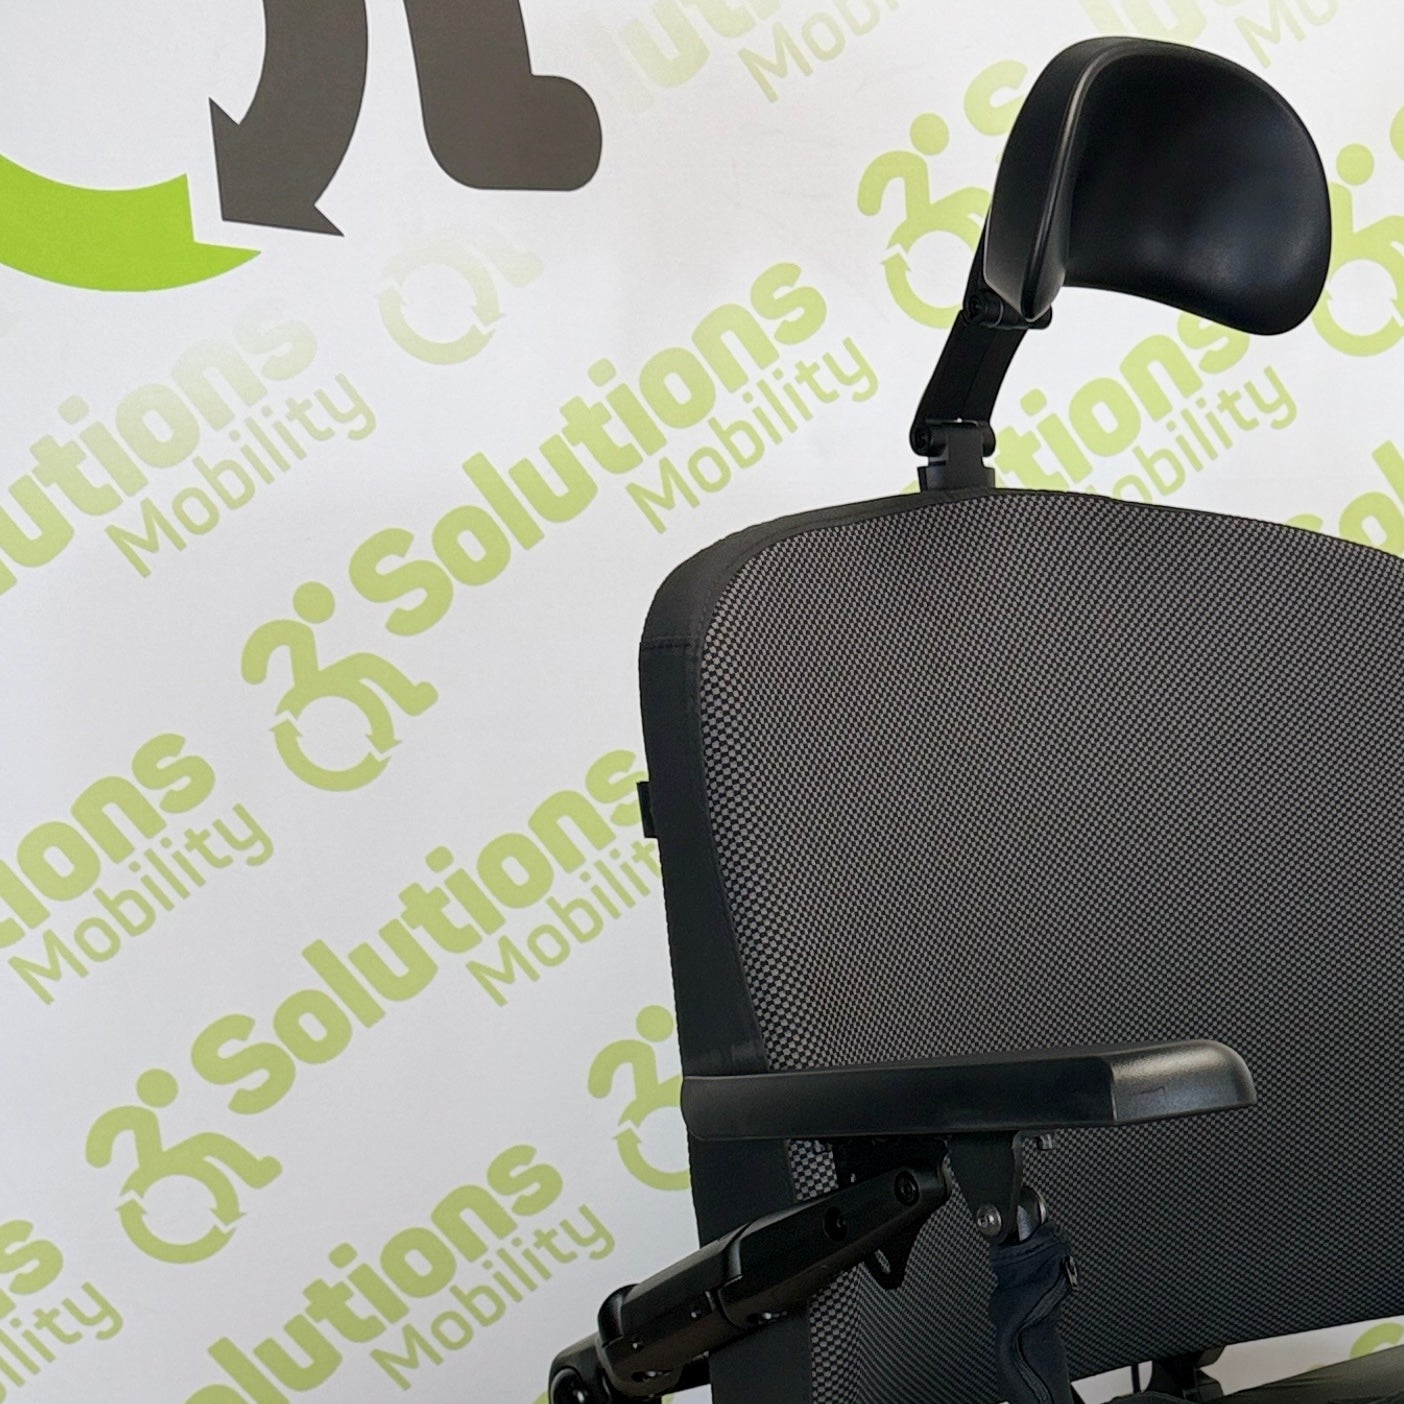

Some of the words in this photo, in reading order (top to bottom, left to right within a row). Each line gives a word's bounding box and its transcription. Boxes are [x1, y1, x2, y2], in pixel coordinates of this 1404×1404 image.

[104, 372, 377, 578] Mobility
[350, 262, 828, 637] Solutions
[624, 336, 880, 535] Mobility
[1086, 366, 1298, 503] obility
[8, 803, 274, 1005] Mobility
[465, 840, 662, 1008] Mobilit
[370, 1203, 615, 1391] Mobility
